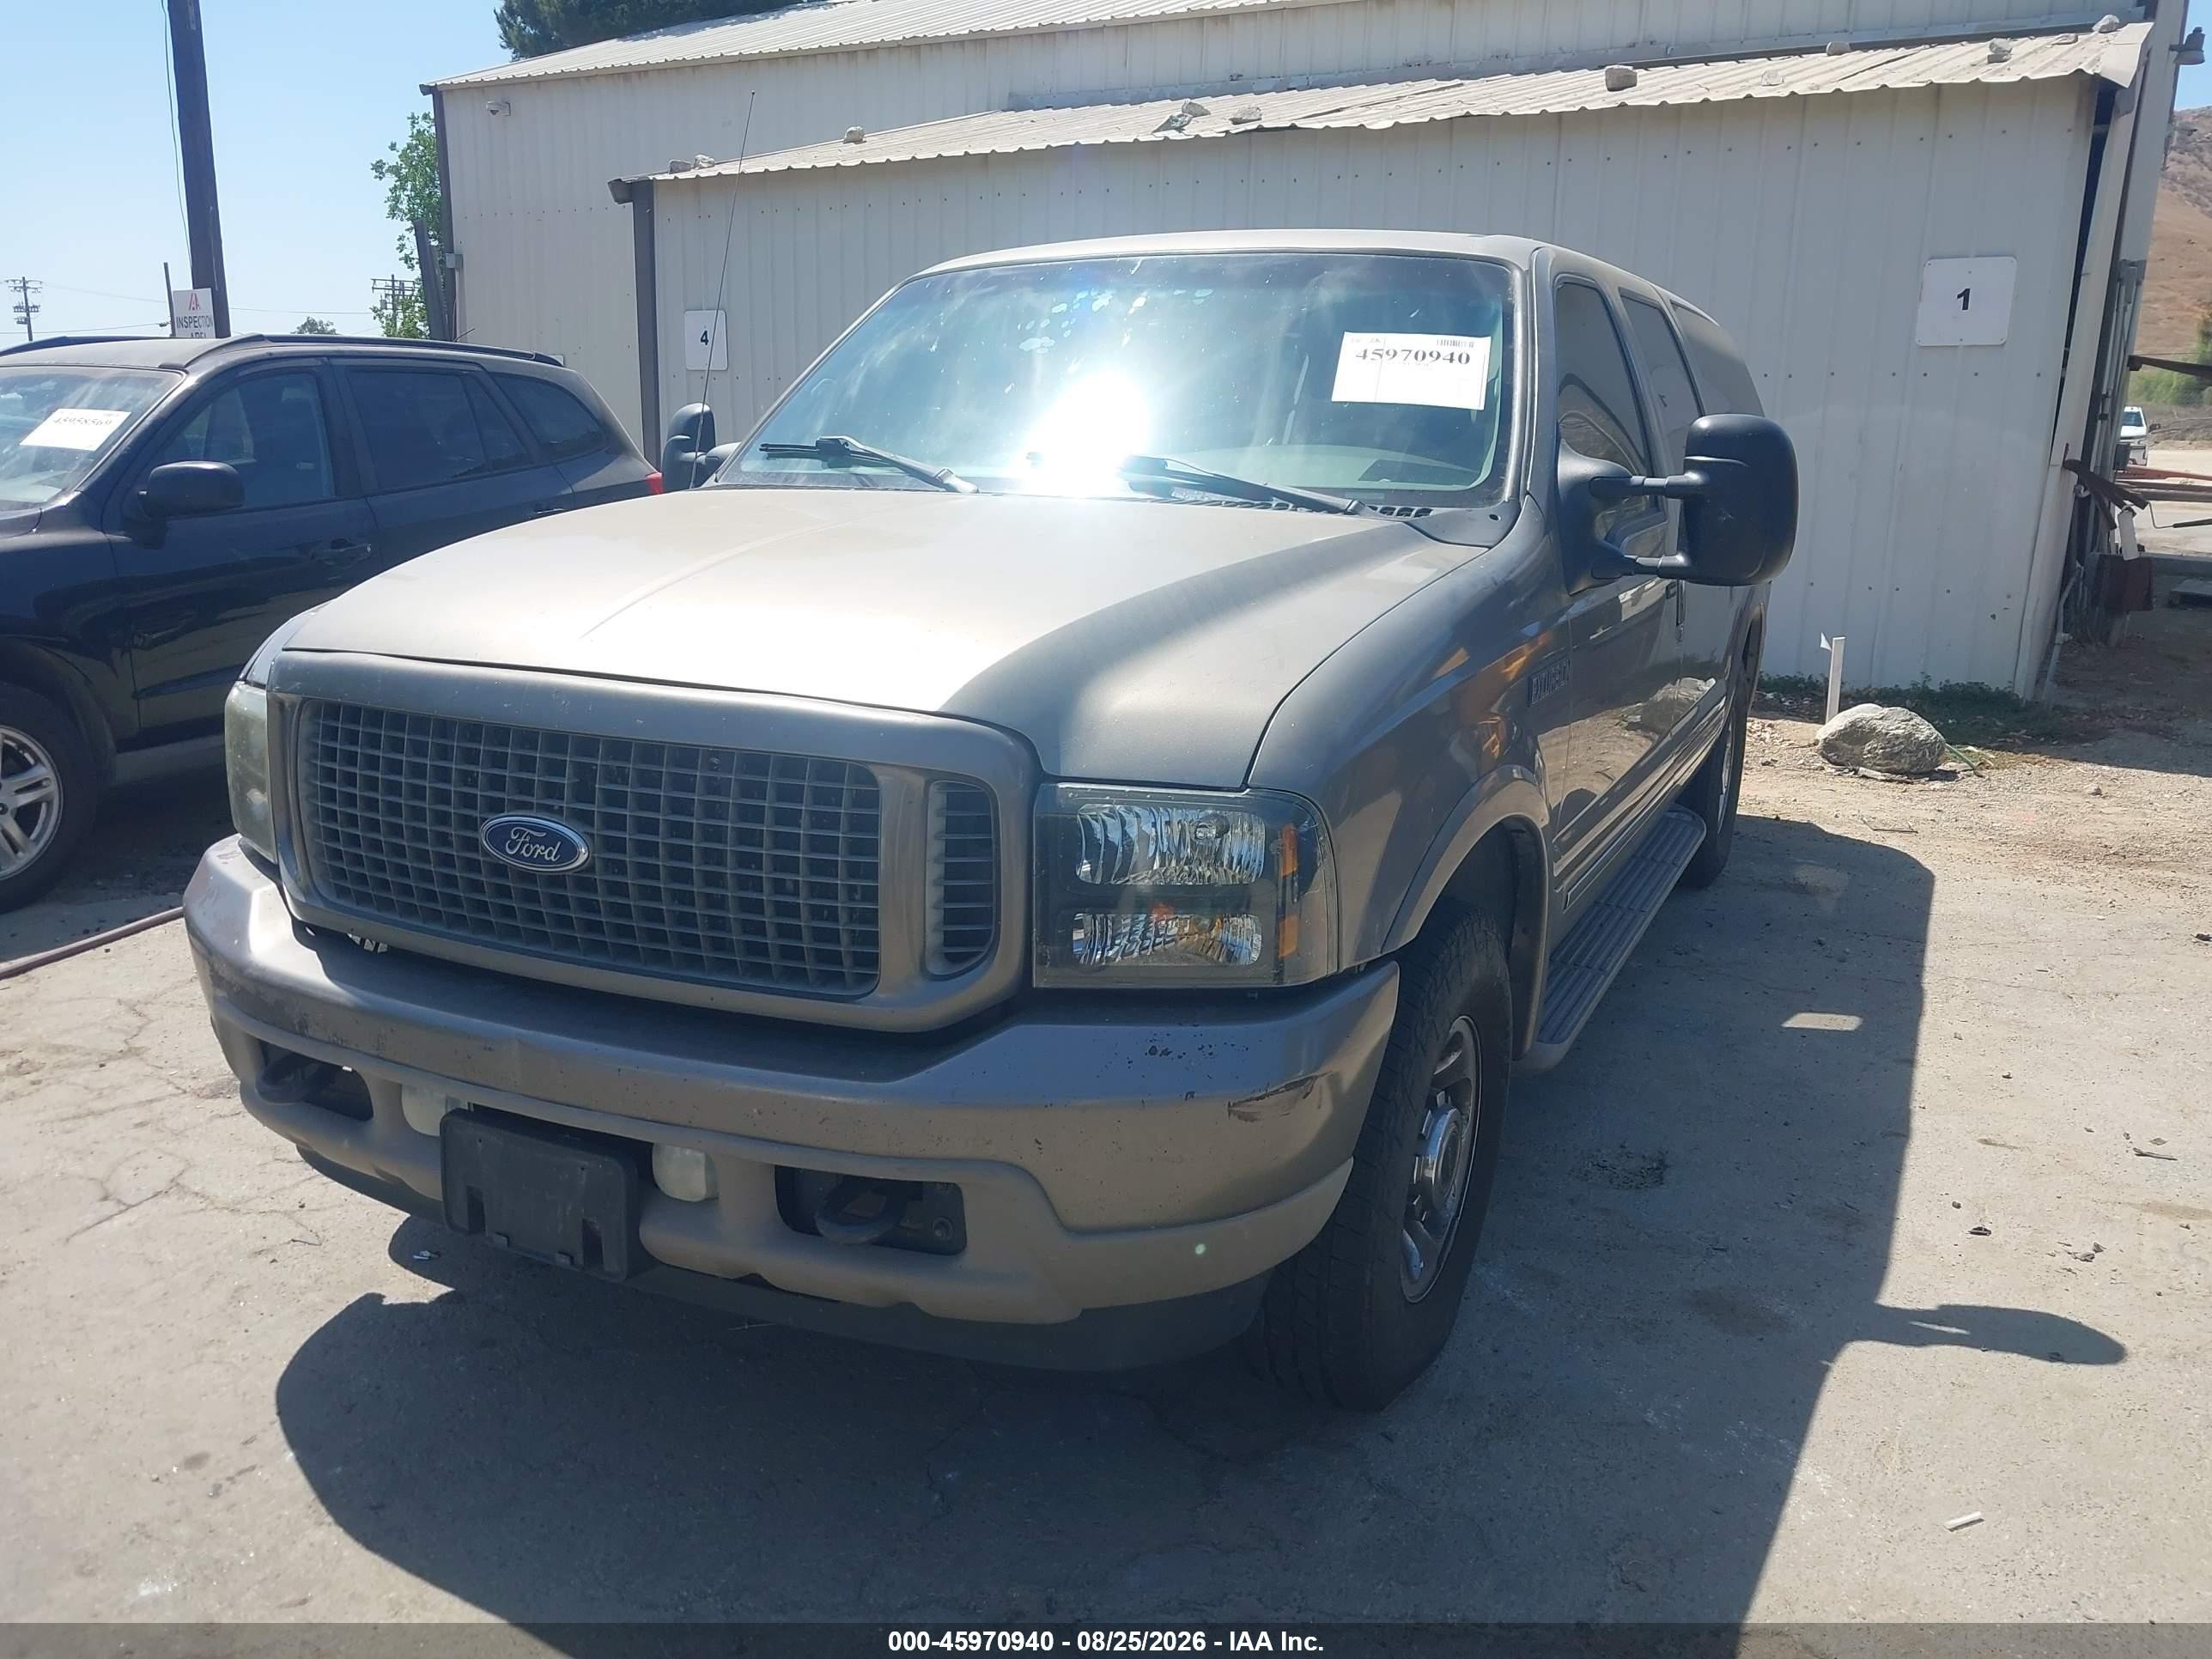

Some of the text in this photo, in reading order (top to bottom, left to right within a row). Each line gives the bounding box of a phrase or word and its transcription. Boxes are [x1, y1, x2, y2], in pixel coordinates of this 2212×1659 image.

[1956, 288, 1972, 311] 1
[175, 315, 214, 329] INSPECTION
[700, 330, 709, 346] 4
[1355, 348, 1471, 365] 45970940
[505, 827, 562, 862] Ford
